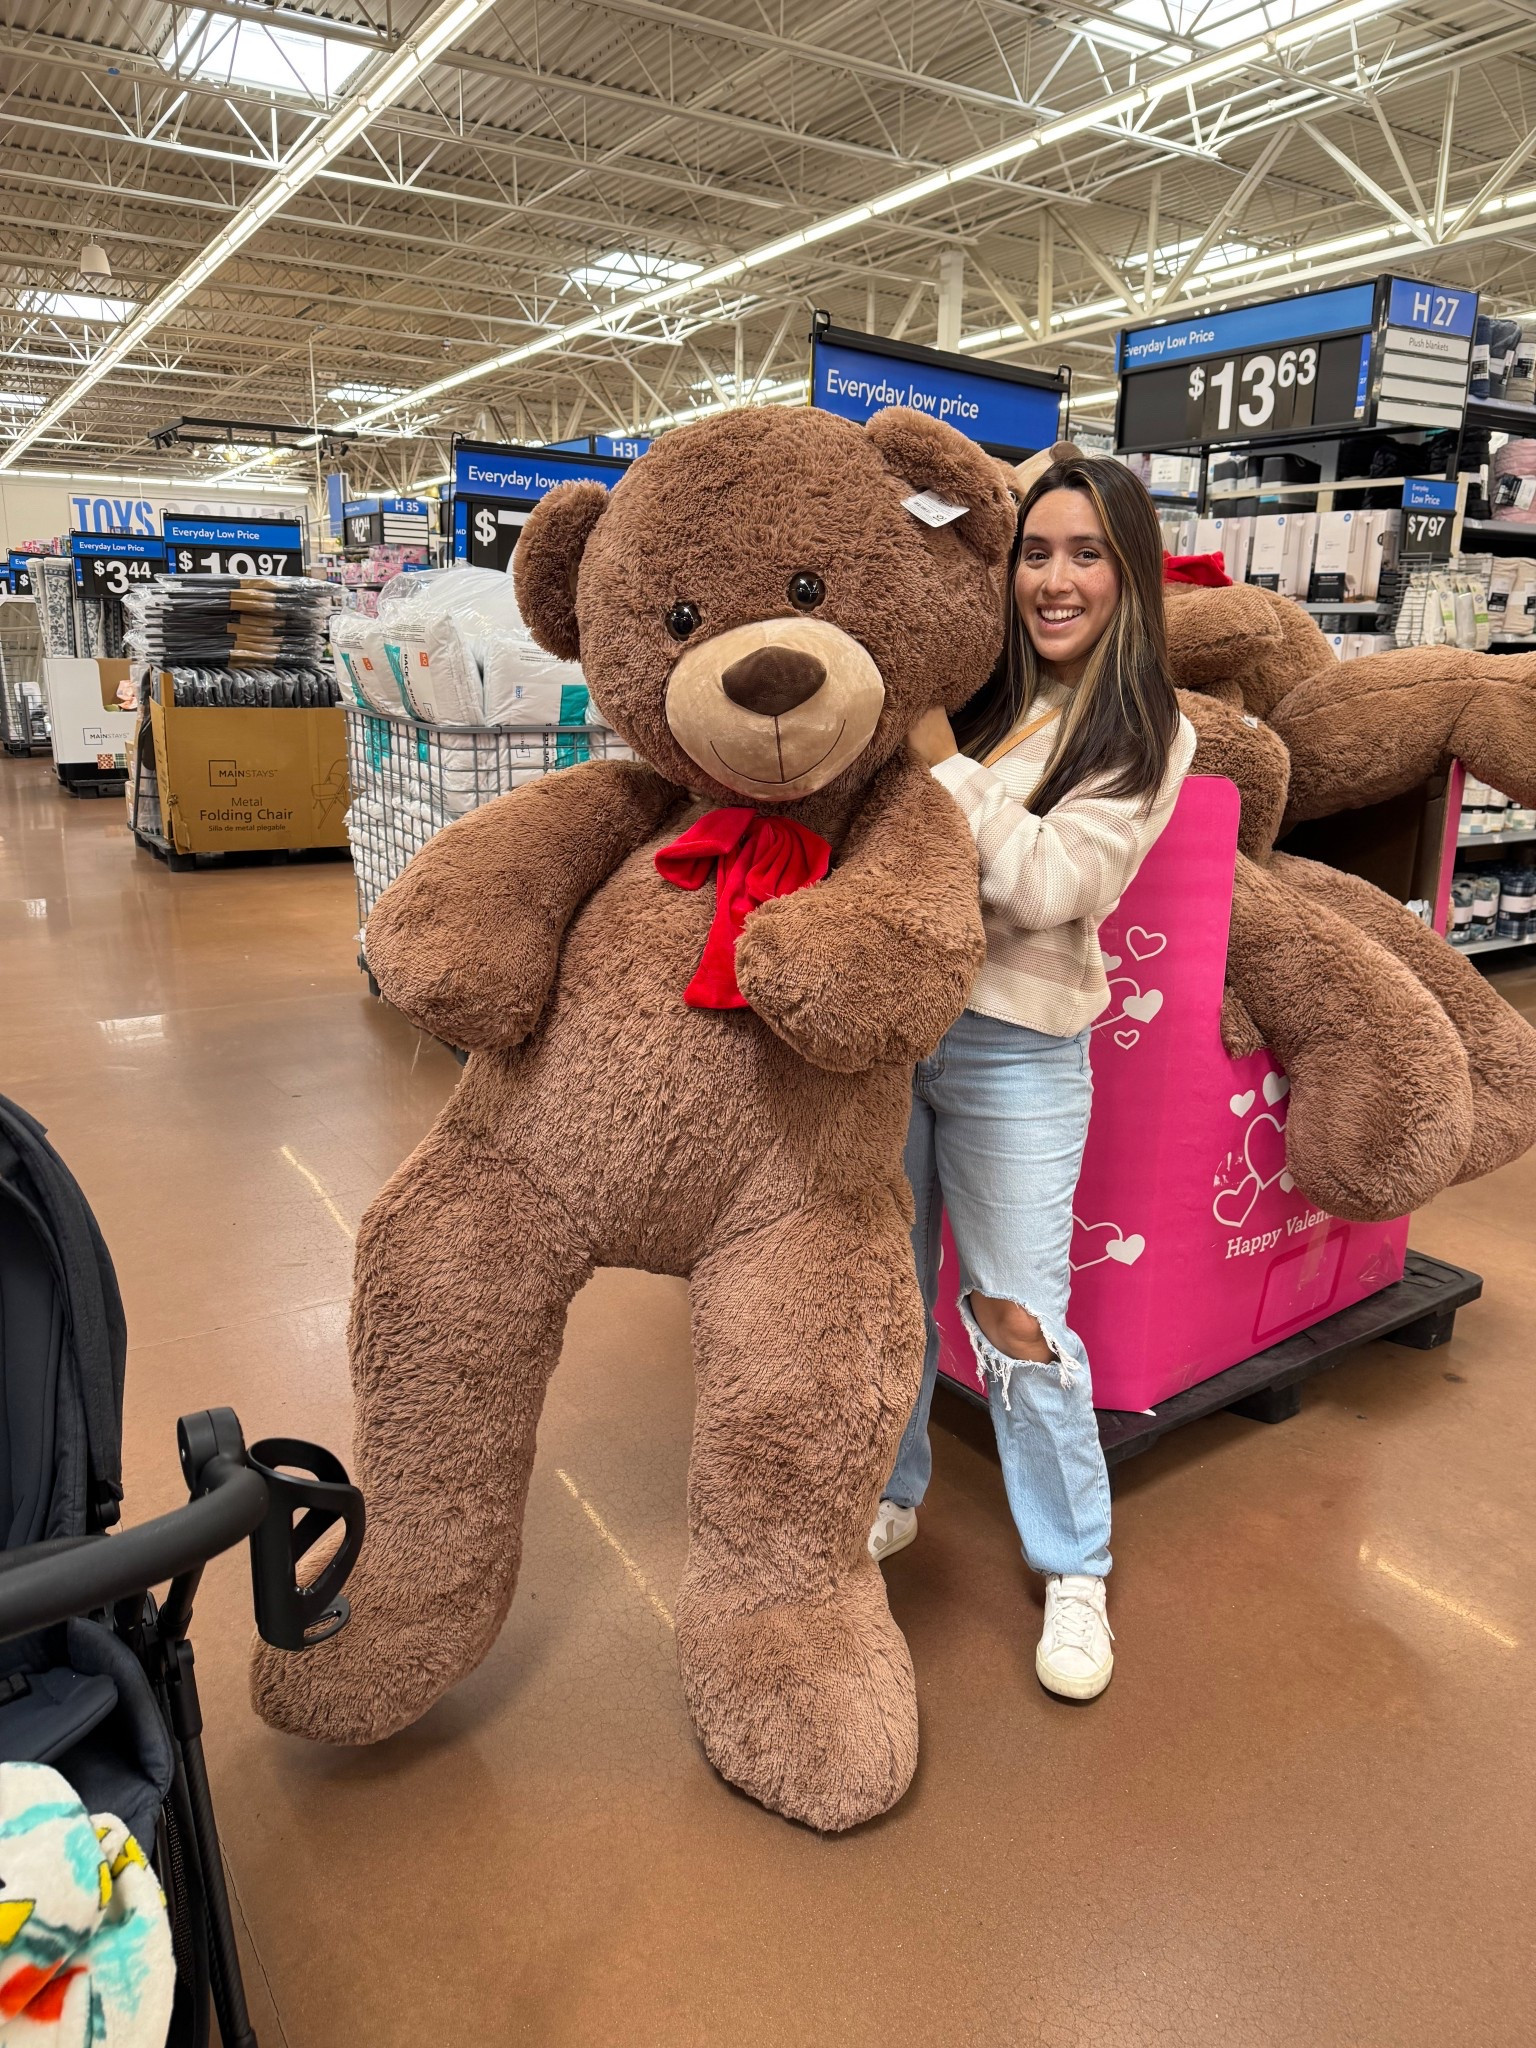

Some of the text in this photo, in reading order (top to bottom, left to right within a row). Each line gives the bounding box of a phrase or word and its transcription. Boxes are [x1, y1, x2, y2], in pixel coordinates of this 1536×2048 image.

[1412, 291, 1460, 327] H 27
[1124, 329, 1215, 358] Everyday Low Price
[1409, 337, 1449, 352] Plush blankets
[826, 368, 979, 419] Everyday low price
[468, 465, 559, 490] Everyday low
[406, 502, 419, 512] 35
[1411, 493, 1440, 506] Low Price
[72, 497, 156, 537] TOYS
[172, 527, 260, 540] Everyday Low Price
[79, 542, 111, 552] Everyday
[218, 769, 275, 778] MAINSTAYS
[231, 797, 262, 807] Metal
[199, 808, 293, 823] Folding Chair
[256, 824, 286, 833] plegable
[1225, 1227, 1283, 1260] Happy
